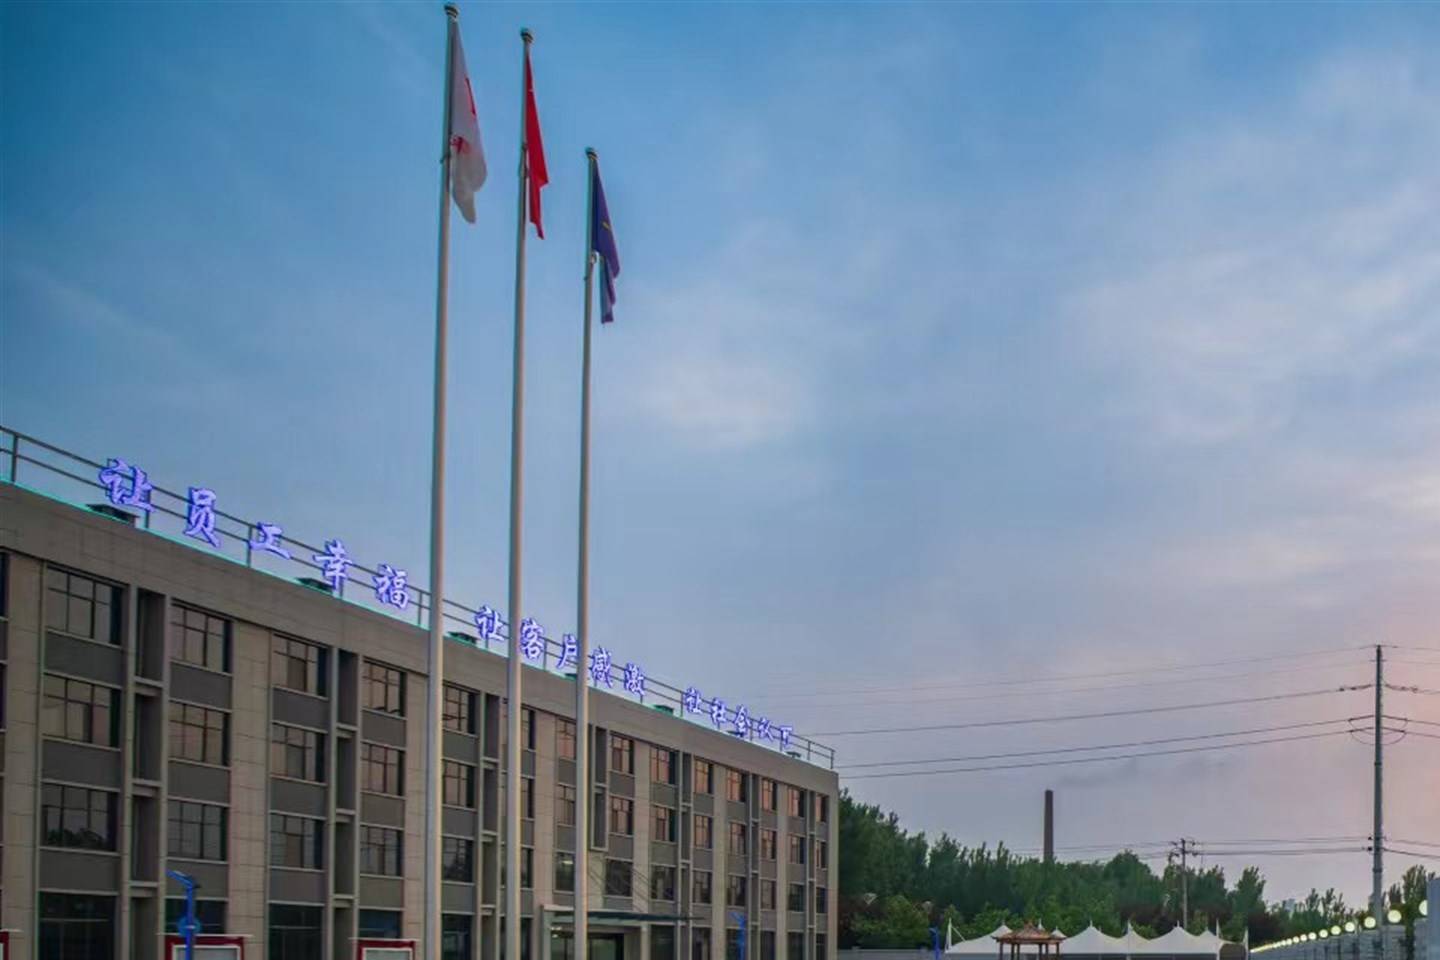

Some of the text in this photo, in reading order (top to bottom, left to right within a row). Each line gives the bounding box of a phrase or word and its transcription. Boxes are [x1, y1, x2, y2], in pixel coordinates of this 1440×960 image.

[100, 457, 410, 610] 让员工幸福
